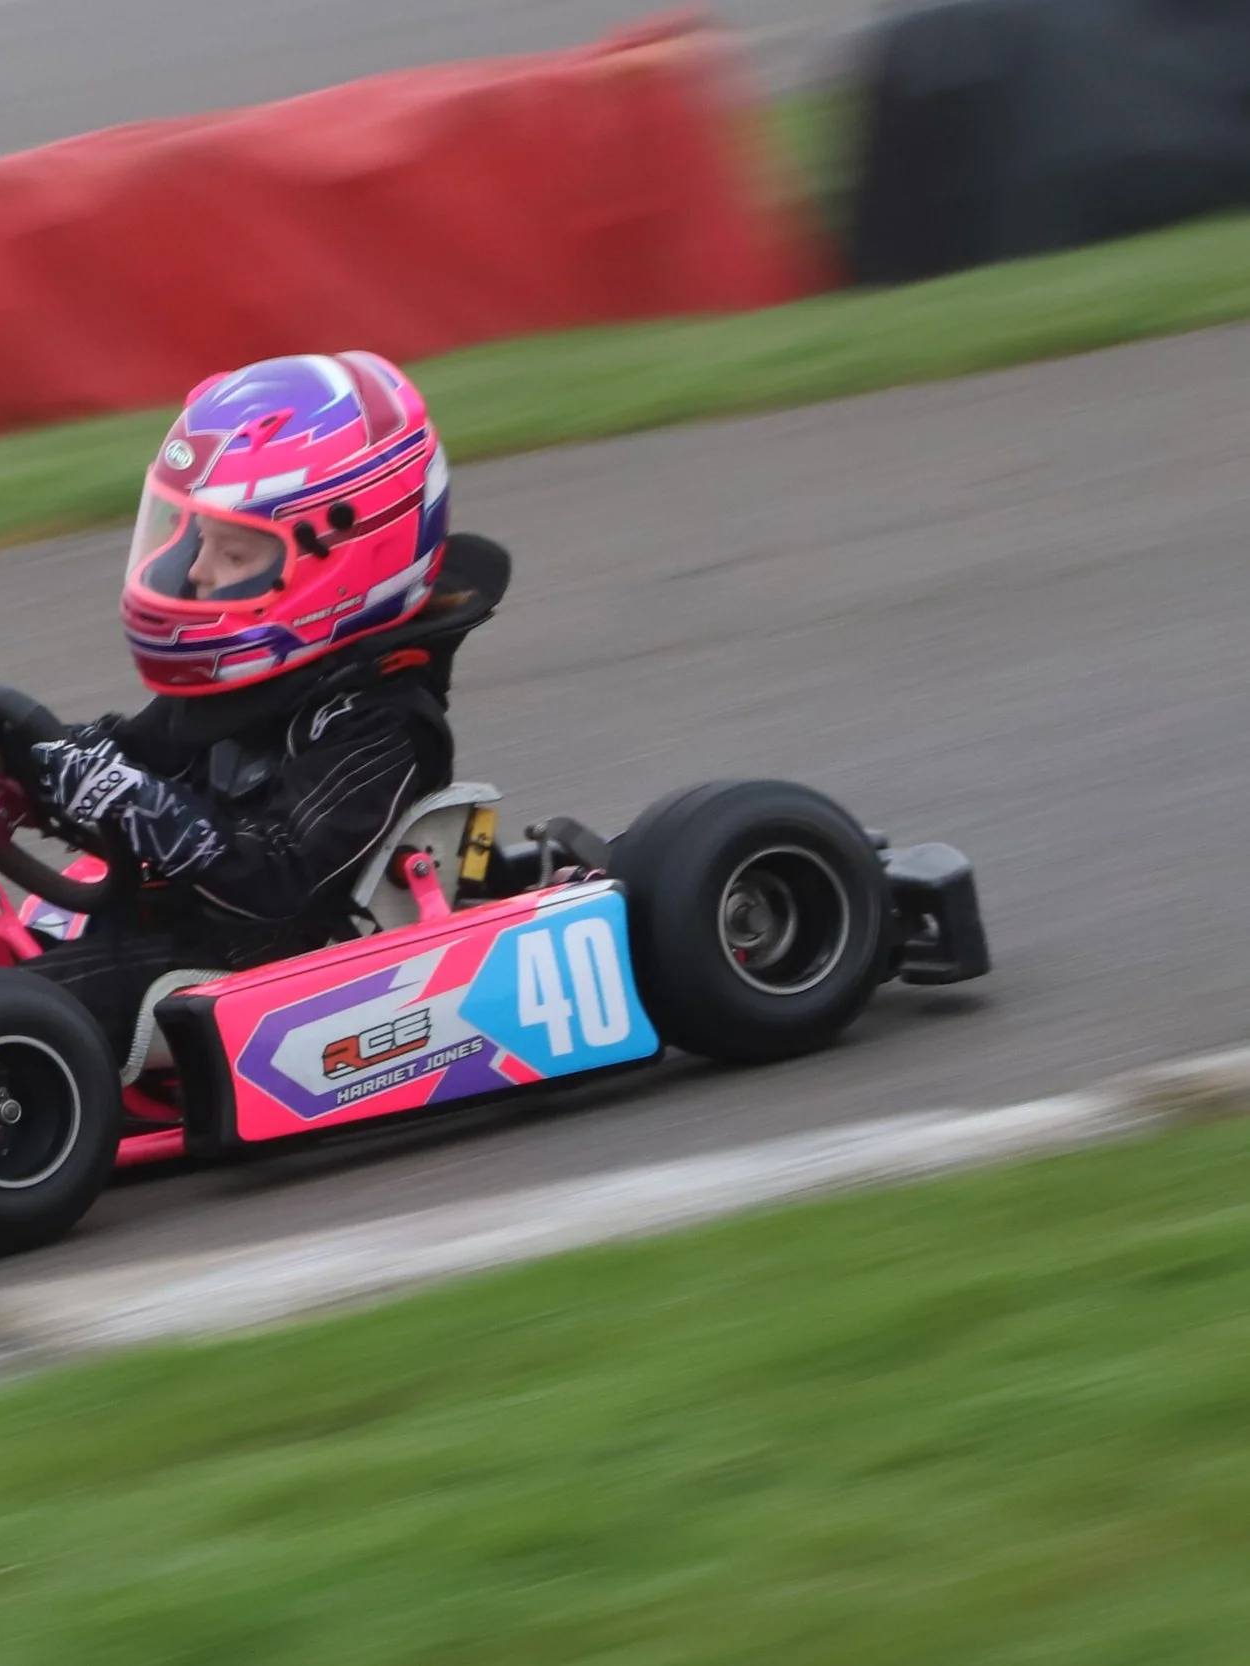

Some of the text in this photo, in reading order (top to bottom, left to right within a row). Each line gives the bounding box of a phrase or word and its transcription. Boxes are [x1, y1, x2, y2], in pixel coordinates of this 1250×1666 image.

[74, 770, 122, 822] parco
[517, 917, 631, 1058] 40
[337, 1038, 483, 1104] HARRIET JONES
